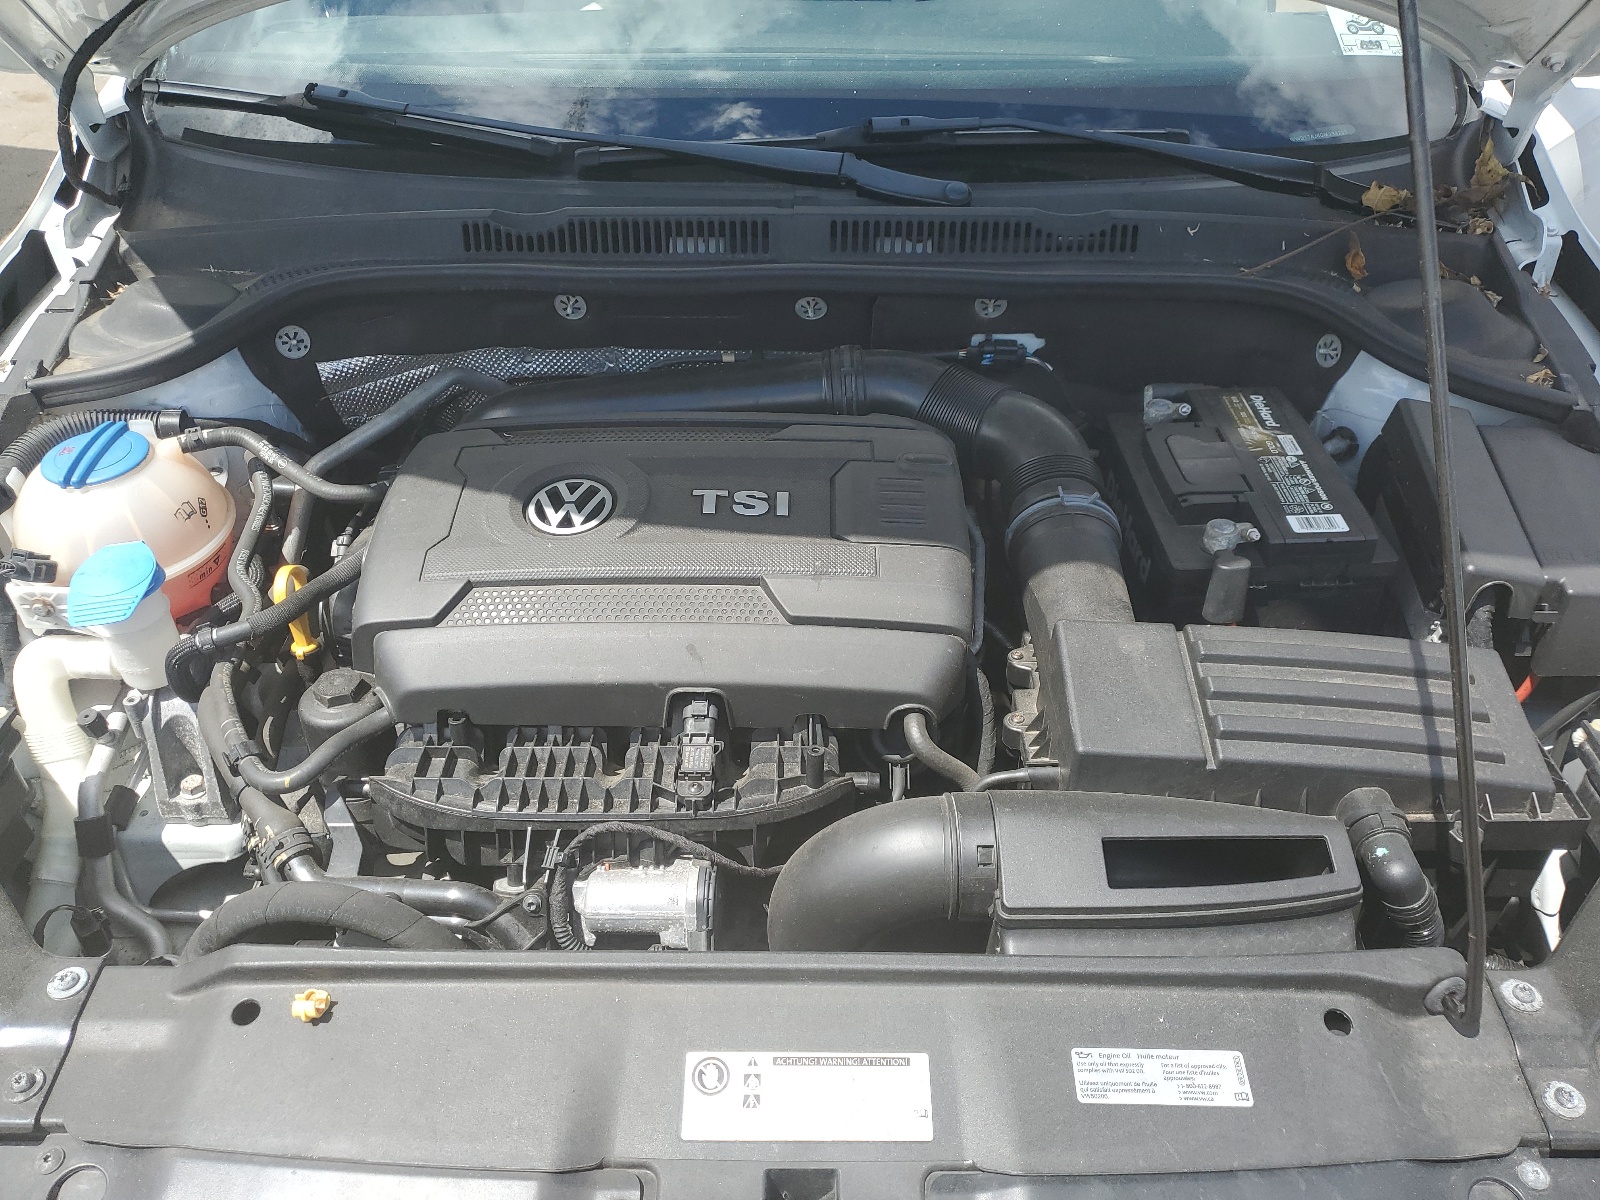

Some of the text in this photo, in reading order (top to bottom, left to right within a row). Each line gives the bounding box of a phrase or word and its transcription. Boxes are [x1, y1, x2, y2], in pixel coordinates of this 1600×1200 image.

[1250, 395, 1281, 427] DieHard
[1266, 440, 1279, 454] GOLD
[692, 489, 790, 517] TSI
[199, 565, 213, 580] min
[775, 1057, 908, 1066] ACHTUNG! WARNING! ATTENTION!
[1098, 1052, 1121, 1061] Engine
[1155, 1053, 1180, 1061] moteur
